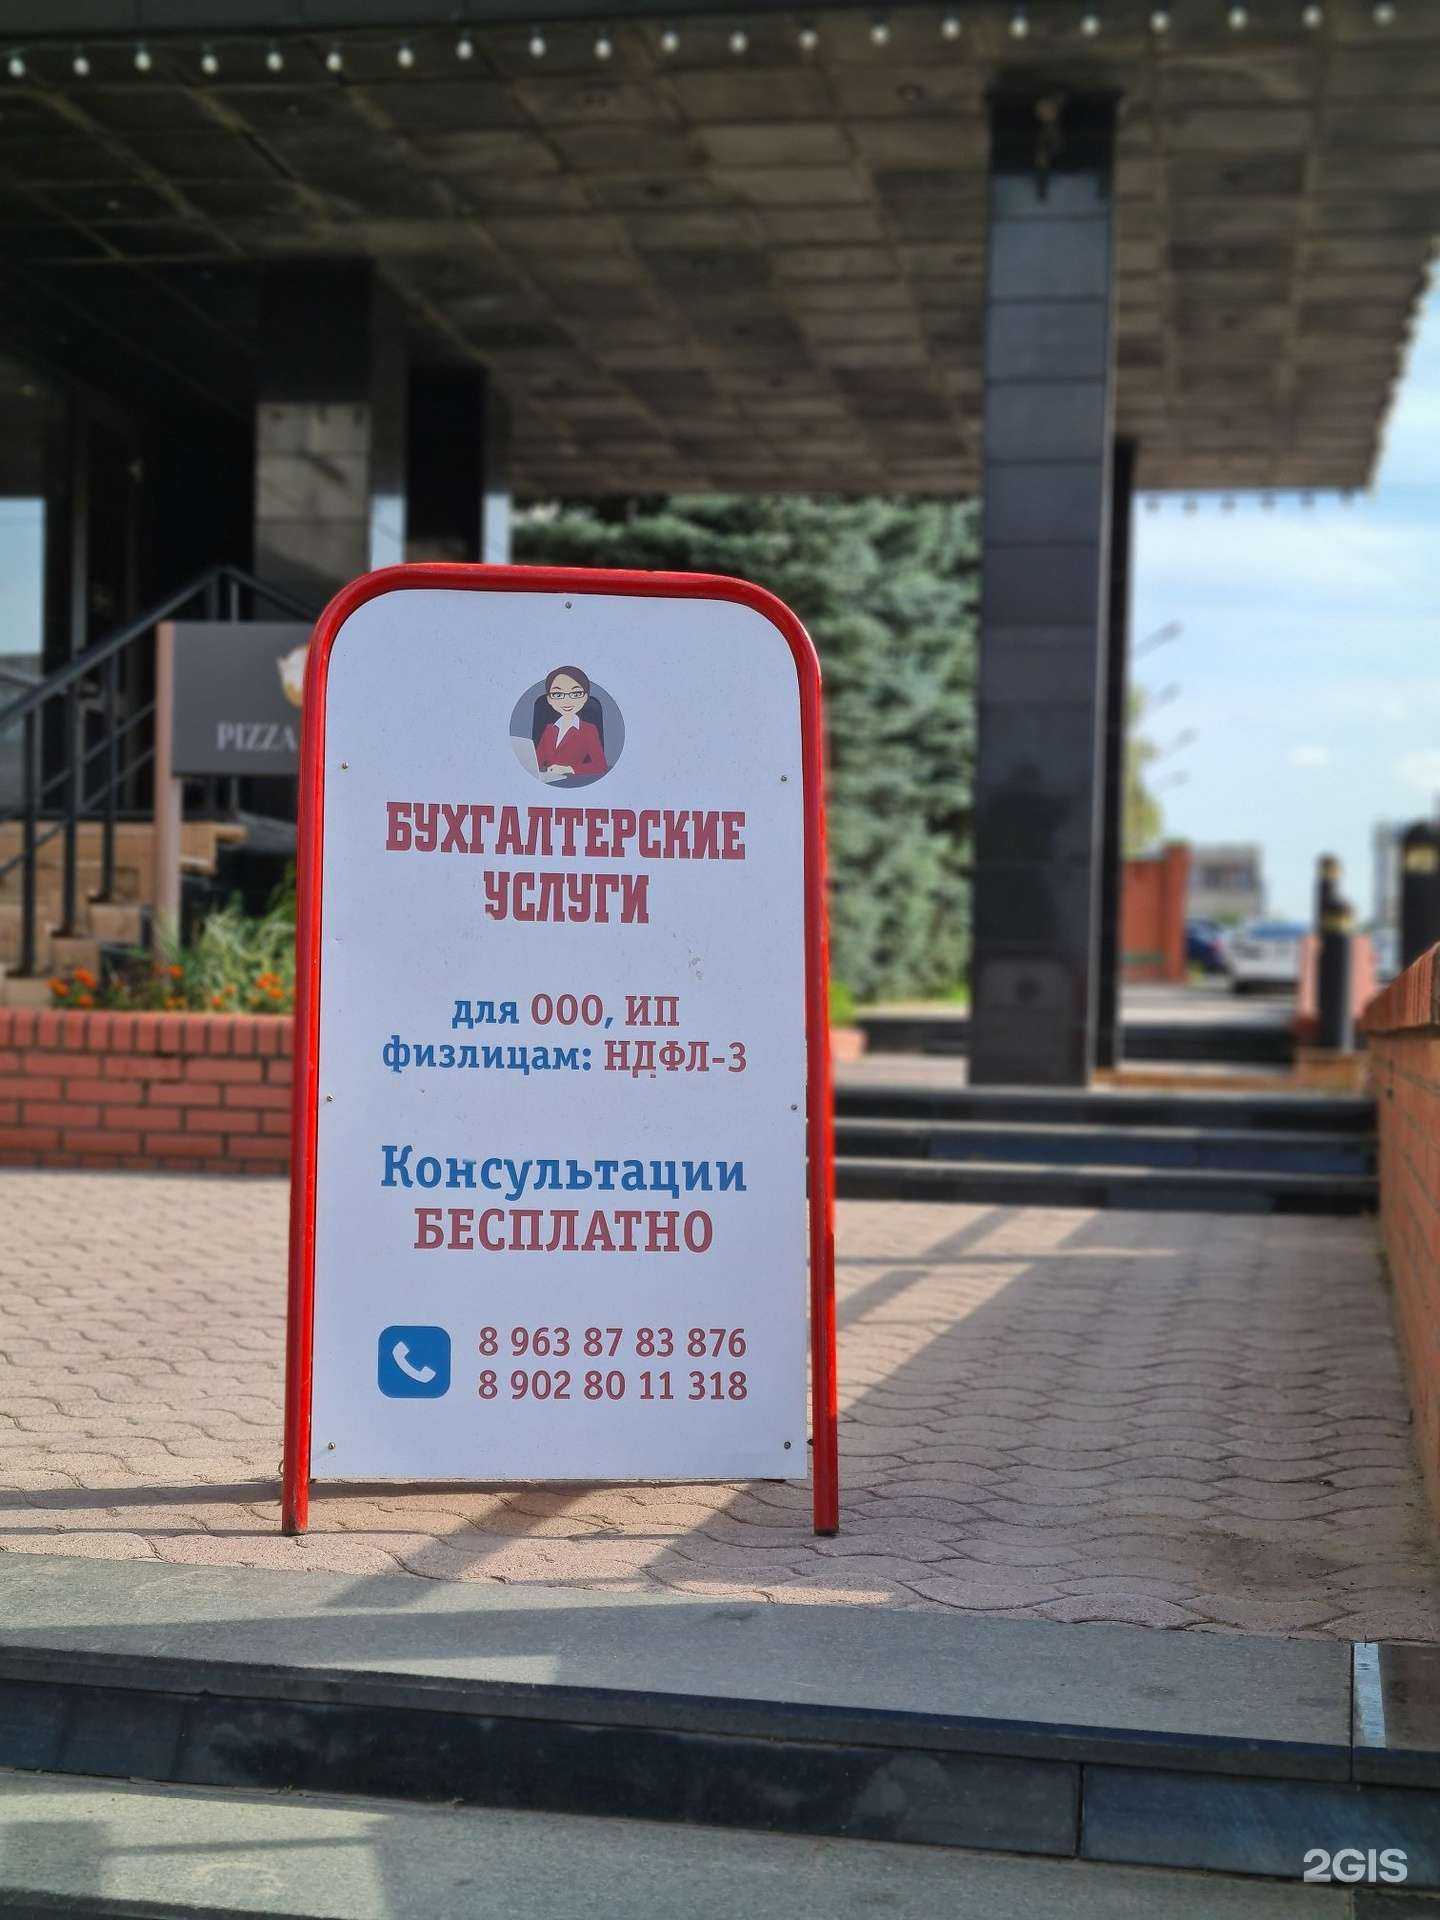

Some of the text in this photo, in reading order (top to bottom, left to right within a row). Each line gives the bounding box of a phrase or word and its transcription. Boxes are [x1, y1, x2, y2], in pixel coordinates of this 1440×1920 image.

[216, 721, 299, 751] PIZZA
[385, 801, 746, 860] БУХГАЛТЕРСКИЕ
[483, 870, 650, 924] УСЛУГИ
[451, 993, 680, 1029] для ООО, ИП
[382, 1034, 747, 1079] физлицам: НДФЛ-3
[381, 1144, 747, 1201] Консультации
[413, 1208, 713, 1253] БЕСПЛАТНО
[478, 1326, 746, 1358] 8 963 87 83 876
[478, 1370, 748, 1401] 8 902 80 11 318
